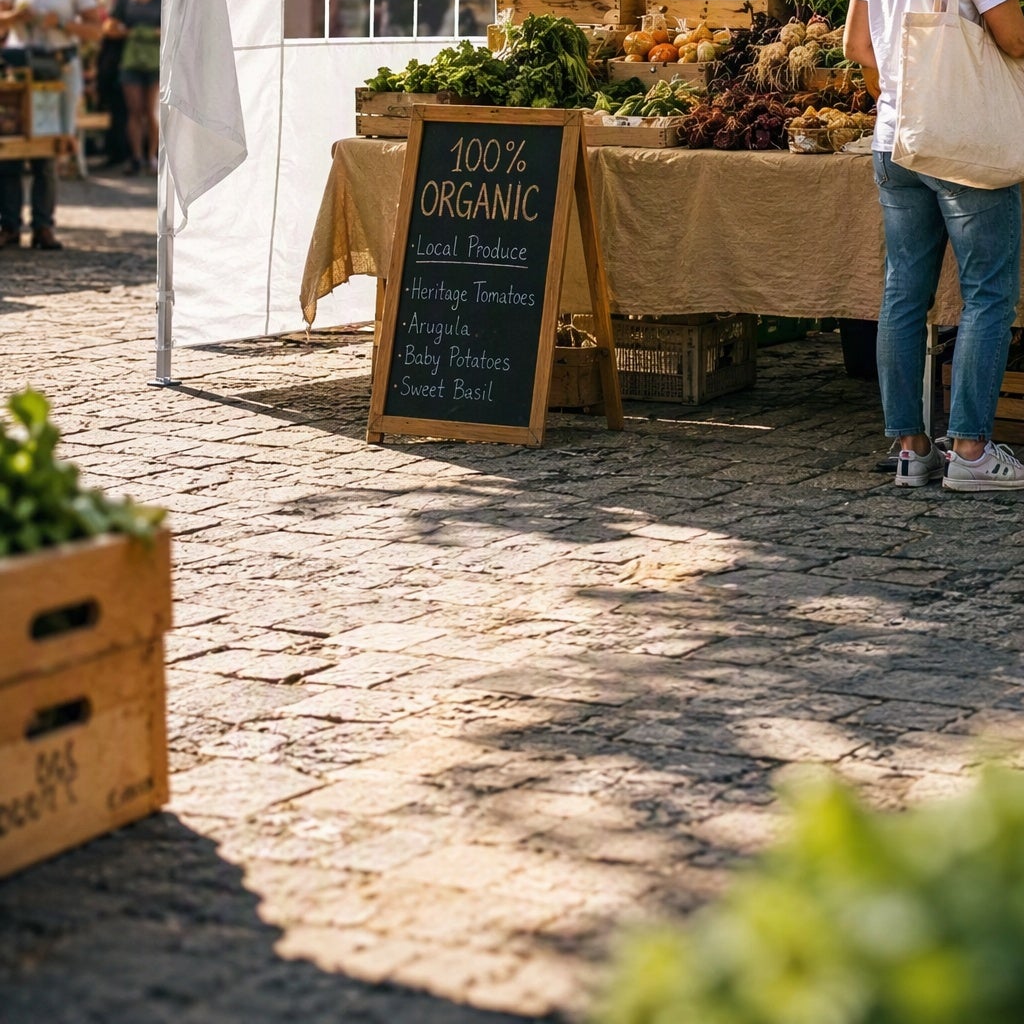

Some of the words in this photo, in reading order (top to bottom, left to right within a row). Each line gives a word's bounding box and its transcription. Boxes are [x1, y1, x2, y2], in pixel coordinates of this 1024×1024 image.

[450, 136, 527, 174] 100%
[420, 180, 540, 222] ORGANIC
[416, 234, 458, 257] Local
[467, 234, 528, 261] Produce
[411, 276, 468, 311] Heritage
[473, 280, 536, 307] Tomatoes
[407, 311, 471, 345] Arugula
[404, 344, 441, 376] Baby
[449, 345, 511, 372] Potatoes
[400, 375, 446, 398] Sweet
[453, 378, 494, 402] Basil
